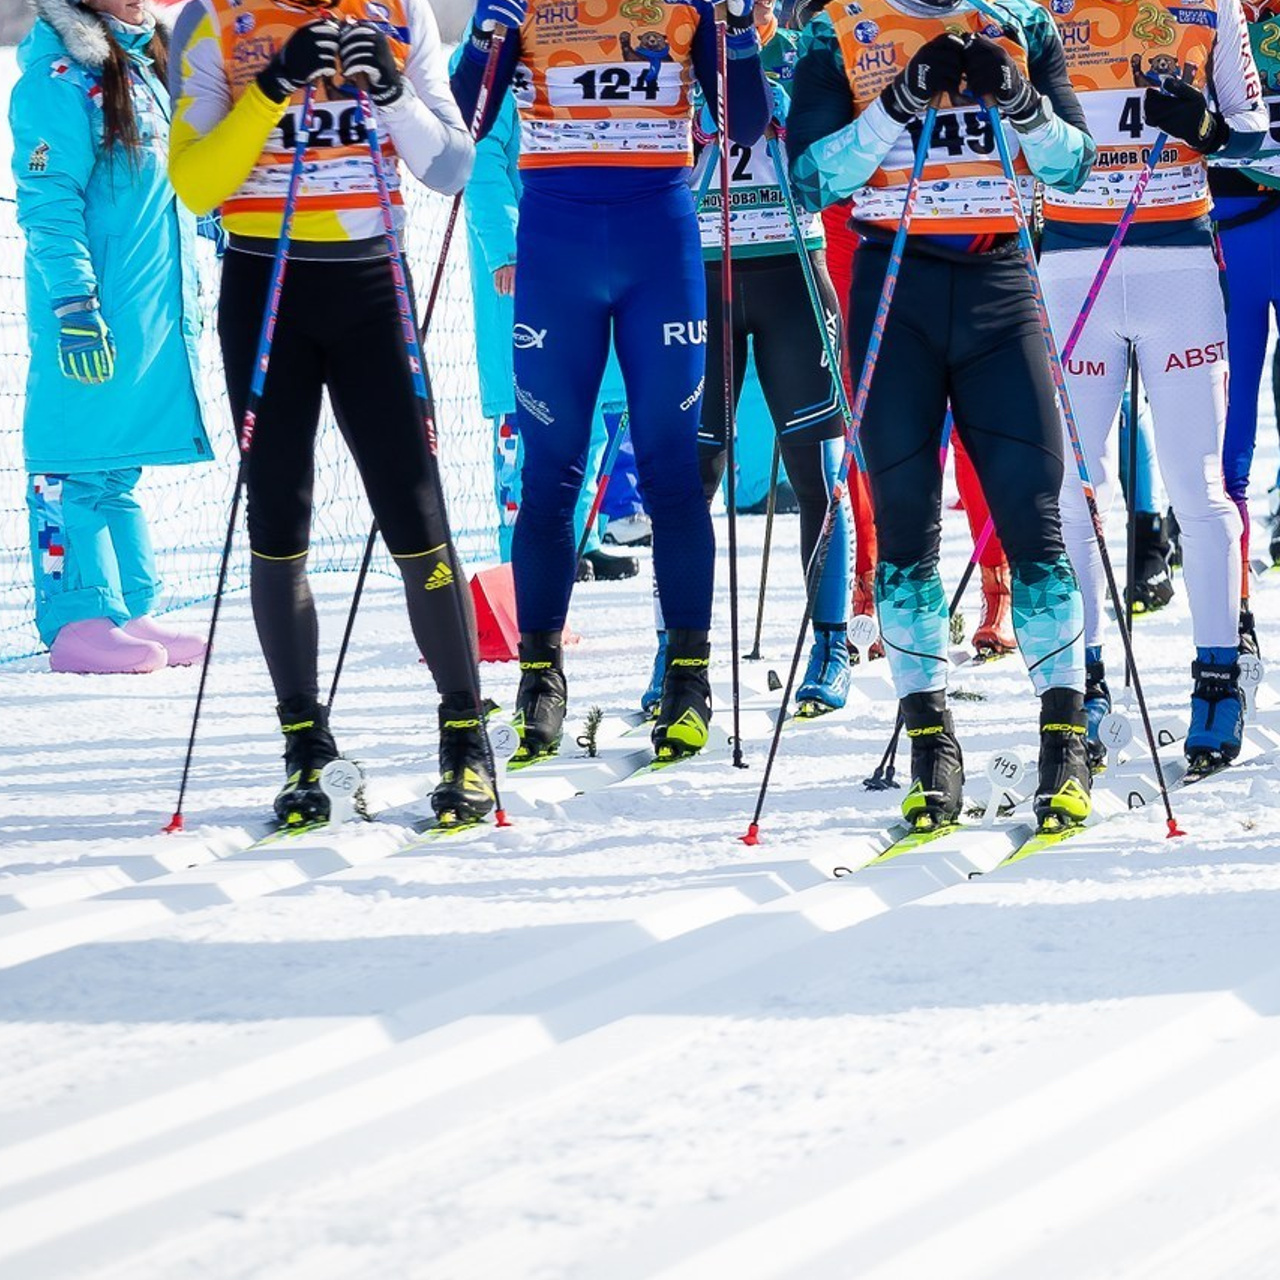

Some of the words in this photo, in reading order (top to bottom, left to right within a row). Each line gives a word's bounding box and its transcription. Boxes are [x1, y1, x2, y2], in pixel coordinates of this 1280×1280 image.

[573, 67, 660, 100] 124
[1095, 150, 1139, 168] диев
[1165, 341, 1225, 372] ABST
[671, 658, 709, 667] FISCH
